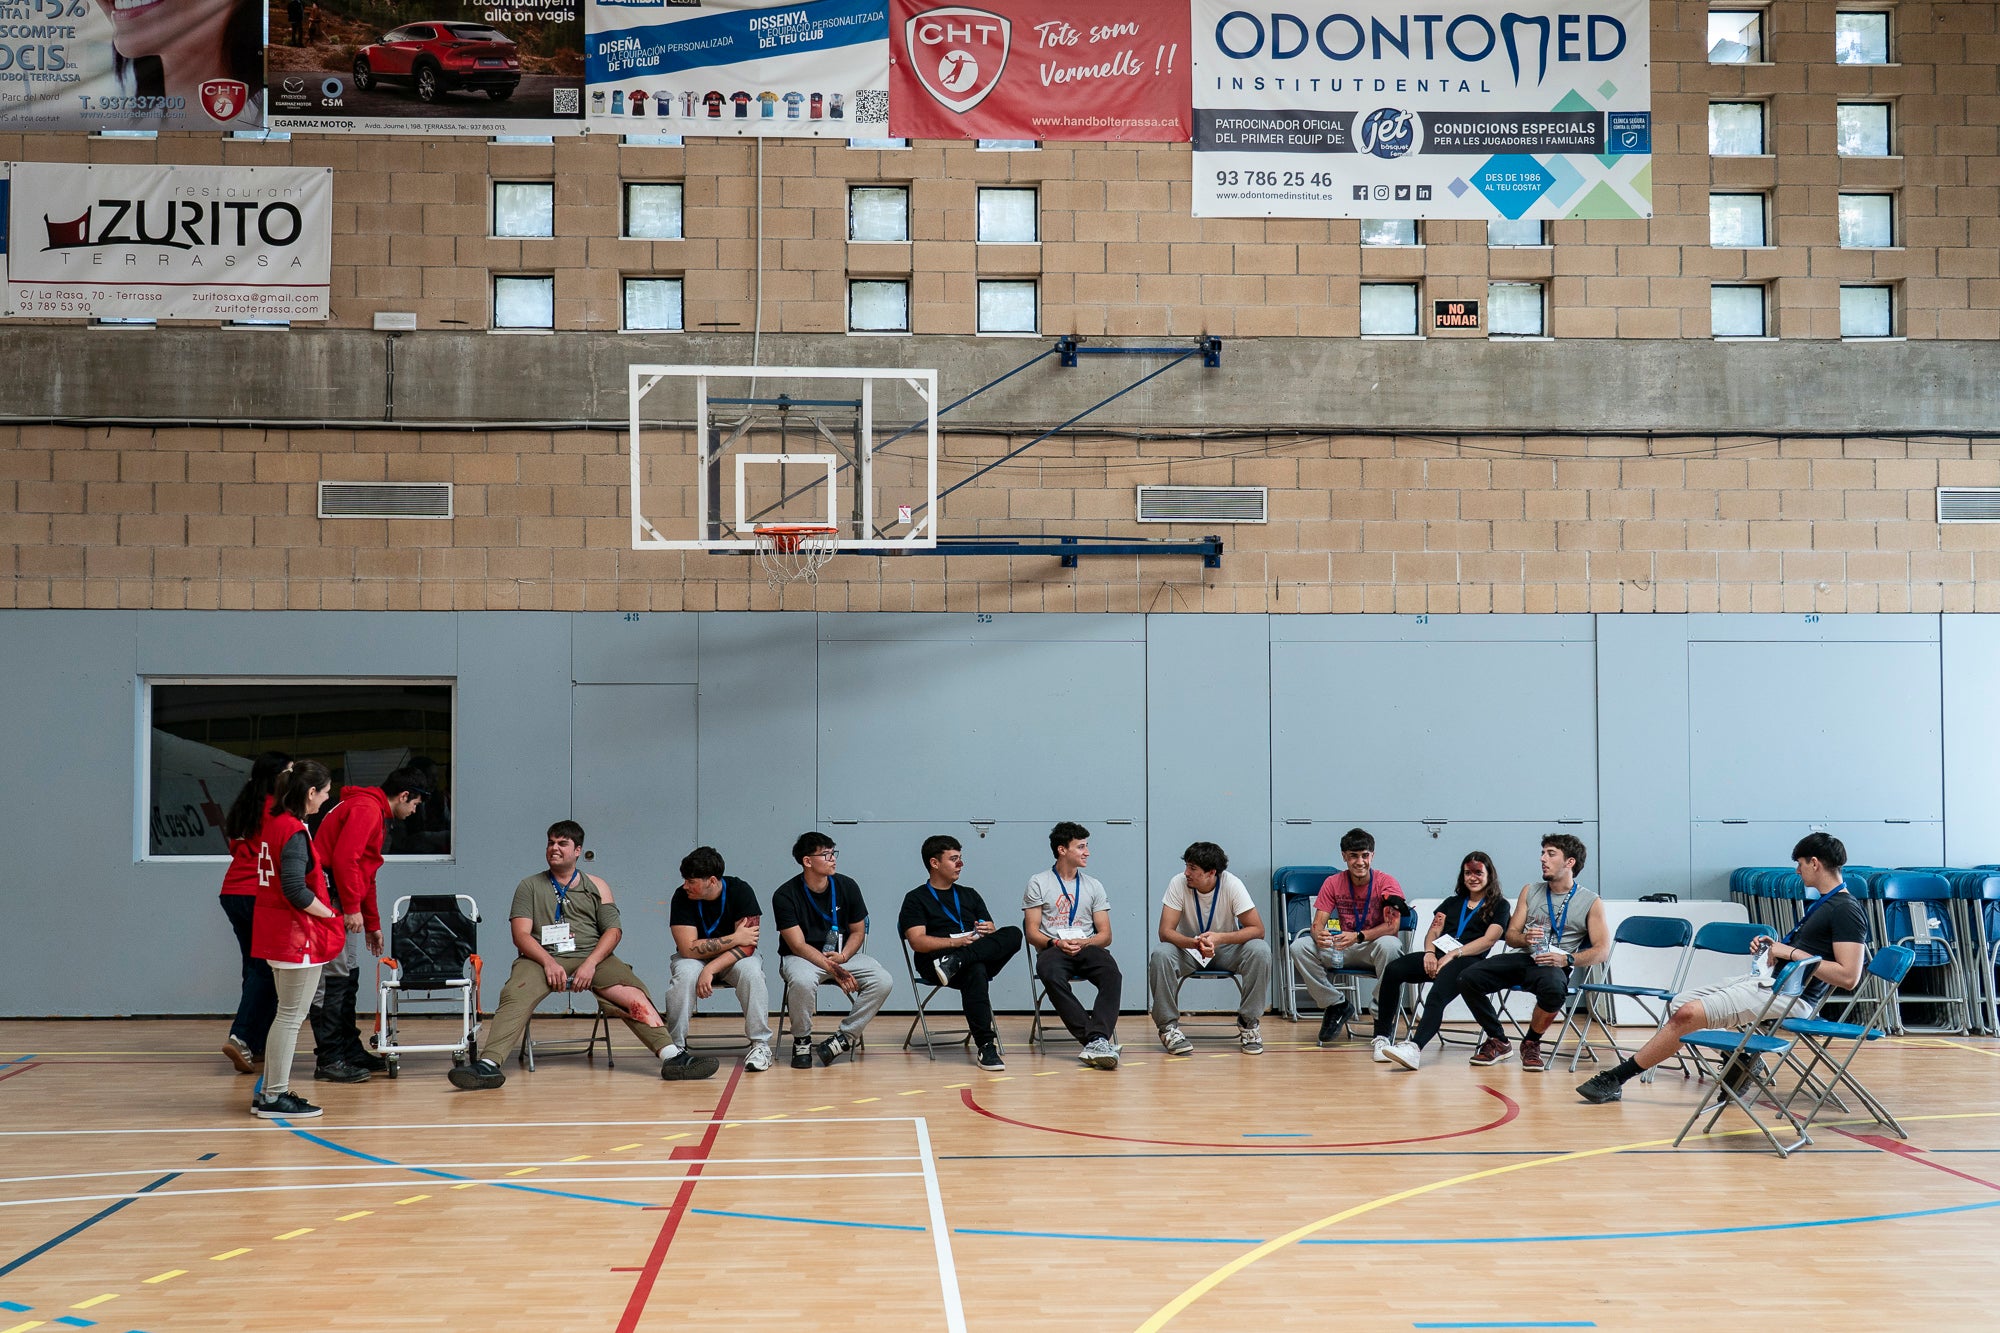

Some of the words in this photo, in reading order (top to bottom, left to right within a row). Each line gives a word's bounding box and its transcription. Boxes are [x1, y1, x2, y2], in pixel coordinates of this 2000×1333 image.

[463, 0, 575, 9] acompanyem
[484, 9, 511, 21] allà
[515, 11, 533, 21] on
[537, 8, 576, 23] vagis
[749, 10, 808, 31] DISSENYA
[812, 11, 884, 31] PERSONALITZADA
[759, 37, 777, 49] DEL
[779, 33, 797, 45] TEU
[799, 29, 824, 42] CLUB
[919, 23, 997, 46] CHT
[1034, 20, 1082, 49] Tots
[1090, 21, 1140, 44] som
[599, 36, 641, 55] DISEÑA
[607, 53, 617, 63] LA
[667, 36, 734, 53] PERSONALIZADA
[1215, 11, 1626, 88] ODONTOMED
[608, 62, 620, 72] DE
[622, 59, 634, 69] TU
[636, 56, 660, 68] CLUB
[1040, 50, 1145, 87] Vermells
[1154, 43, 1178, 76] !!
[0, 73, 28, 81] DBOL
[30, 73, 81, 82] TERRASSA
[204, 85, 243, 96] CHT
[2, 93, 21, 101] Parc
[40, 93, 60, 101] Nord
[79, 96, 96, 109] T.
[100, 96, 186, 109] 937337300
[321, 98, 344, 107] CSM
[80, 111, 187, 119] www.centredental.com
[1032, 115, 1179, 127] www.handbolterrassa.cat
[274, 120, 319, 128] EGARMAZ
[320, 121, 356, 129] MOTOR.
[1215, 119, 1300, 131] PATROCINADOR
[1302, 120, 1345, 131] OFICIAL
[1434, 123, 1518, 134] CONDICIONS
[1522, 122, 1595, 133] ESPECIALS
[1361, 109, 1413, 154] jet
[1215, 133, 1237, 144] DEL
[1241, 133, 1284, 144] PRIMER
[1288, 134, 1323, 145] EQUIP
[1327, 134, 1345, 145] DE:
[1434, 137, 1452, 145] PER
[1454, 137, 1461, 145] A
[1463, 137, 1480, 145] LES
[1482, 137, 1538, 145] JUGADORES
[1546, 137, 1595, 145] FAMILIARS
[1216, 170, 1239, 186] 93
[1244, 170, 1277, 187] 786
[1283, 171, 1305, 187] 25
[1310, 172, 1332, 187] 46
[1485, 174, 1503, 182] DES
[1505, 174, 1517, 182] DE
[1519, 173, 1541, 182] 1986
[175, 184, 304, 198] restaurant
[1216, 190, 1333, 200] www.odontomedinstitut.es
[98, 199, 303, 247] ZURITO
[60, 252, 302, 267] TERRASSA
[20, 289, 35, 301] C/
[39, 290, 52, 300] La
[56, 290, 88, 302] Rasa,
[91, 291, 105, 301] 70
[116, 291, 162, 301] Terrassa
[192, 292, 319, 303] zuritosaxa@gmail.com
[20, 302, 34, 312] 93
[37, 302, 57, 312] 789
[60, 302, 74, 312] 53
[77, 302, 91, 312] 90
[214, 304, 319, 315] zuritoterrassa.com
[1448, 303, 1465, 315] NO
[1436, 314, 1477, 326] FUMAR
[624, 613, 640, 621] 48
